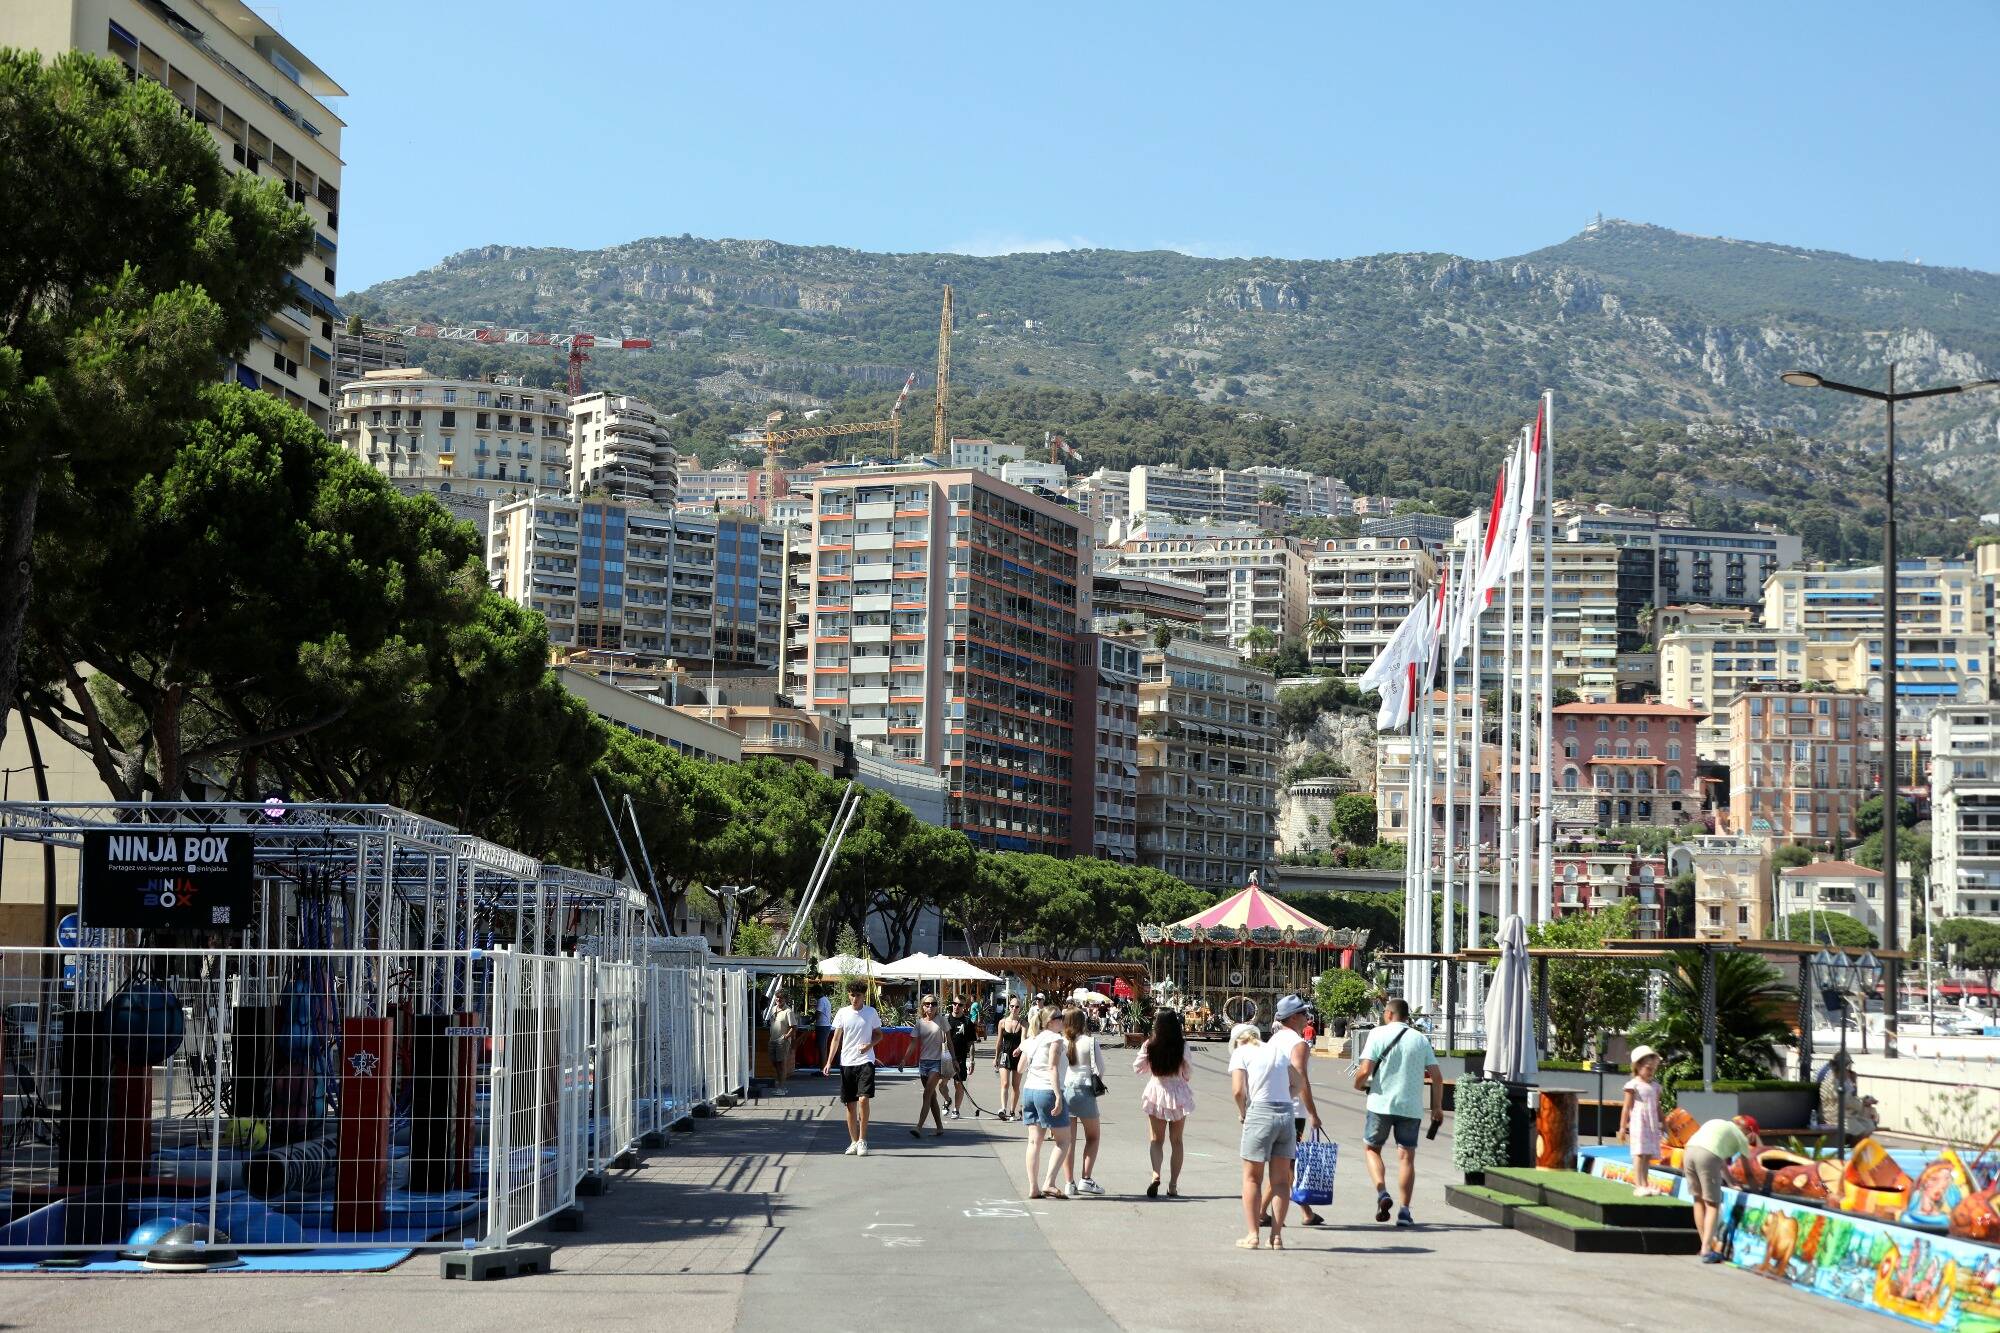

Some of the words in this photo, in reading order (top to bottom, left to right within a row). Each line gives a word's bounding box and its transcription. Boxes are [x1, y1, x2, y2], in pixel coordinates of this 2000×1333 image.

[108, 835, 178, 862] NINJA
[184, 836, 229, 863] BOX
[108, 864, 136, 873] Partagez
[148, 864, 170, 873] images
[137, 878, 199, 892] NINJA
[143, 891, 192, 908] BOX
[448, 1027, 482, 1035] HERAS
